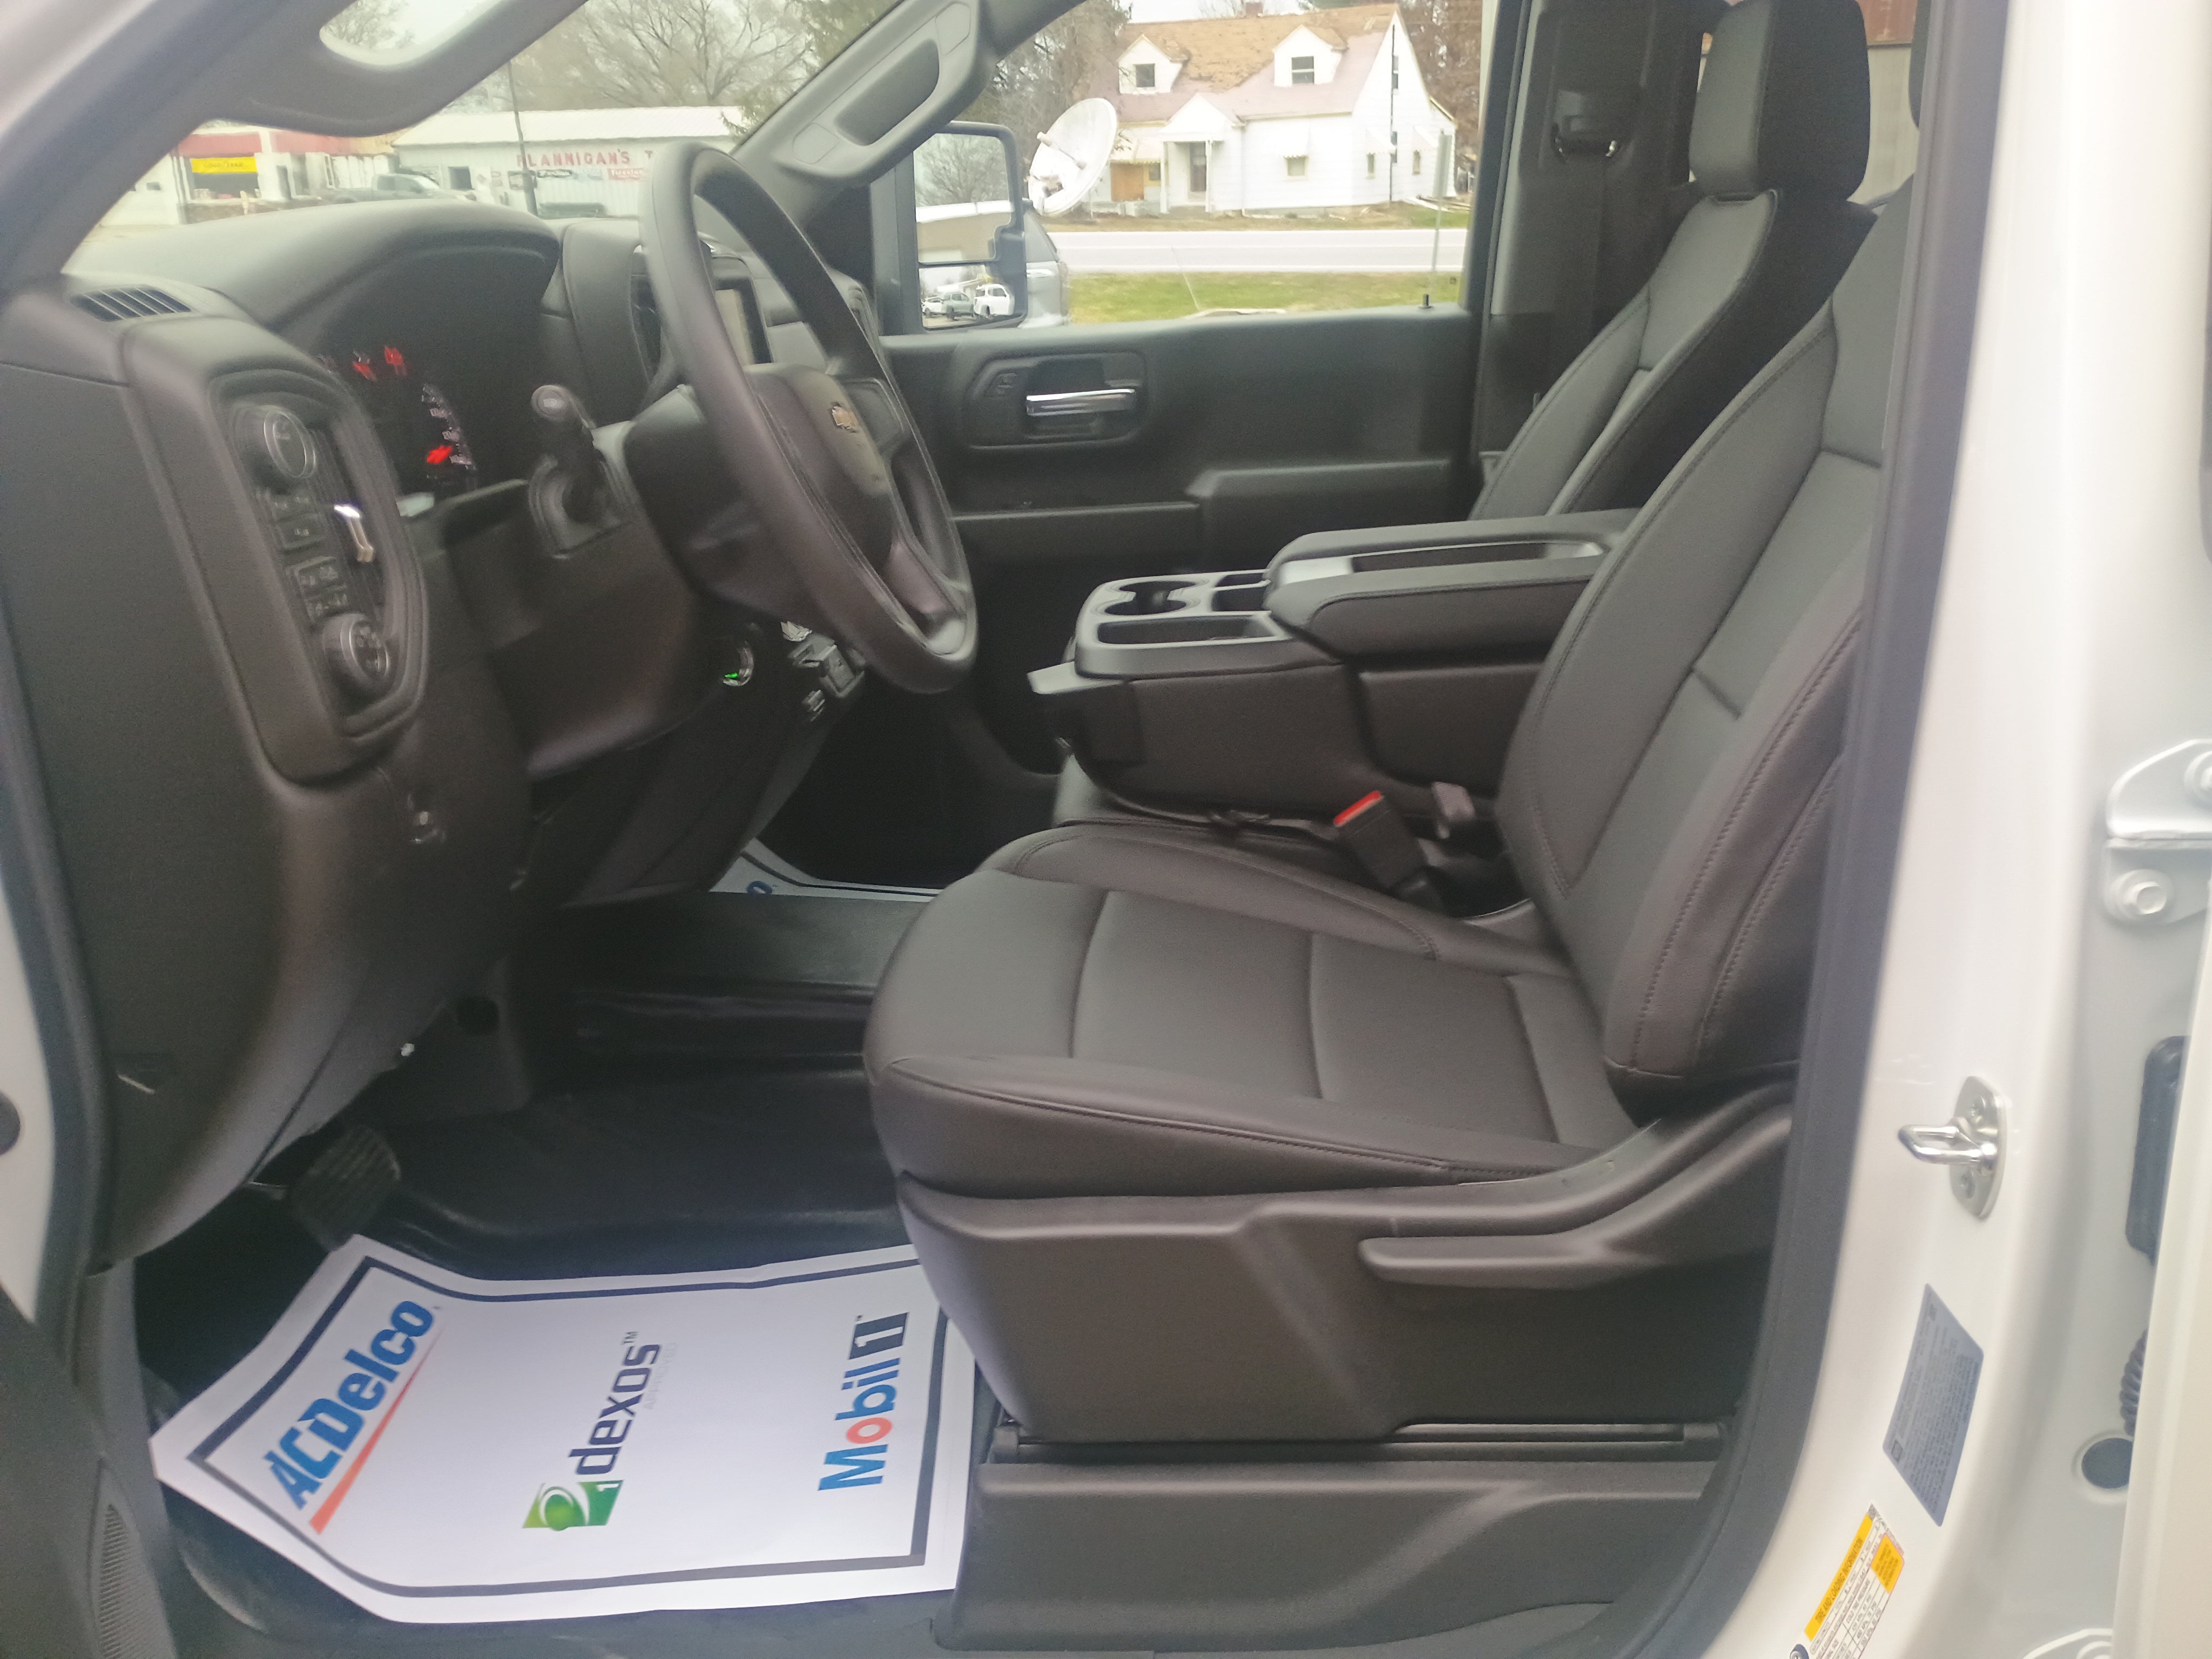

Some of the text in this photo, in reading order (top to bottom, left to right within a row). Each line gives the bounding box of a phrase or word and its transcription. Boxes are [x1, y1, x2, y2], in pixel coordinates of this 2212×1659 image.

[264, 1300, 434, 1509] ACDelco
[568, 1343, 662, 1475] dexos
[818, 1357, 901, 1491] Mobil
[1823, 1596, 1832, 1610] AND
